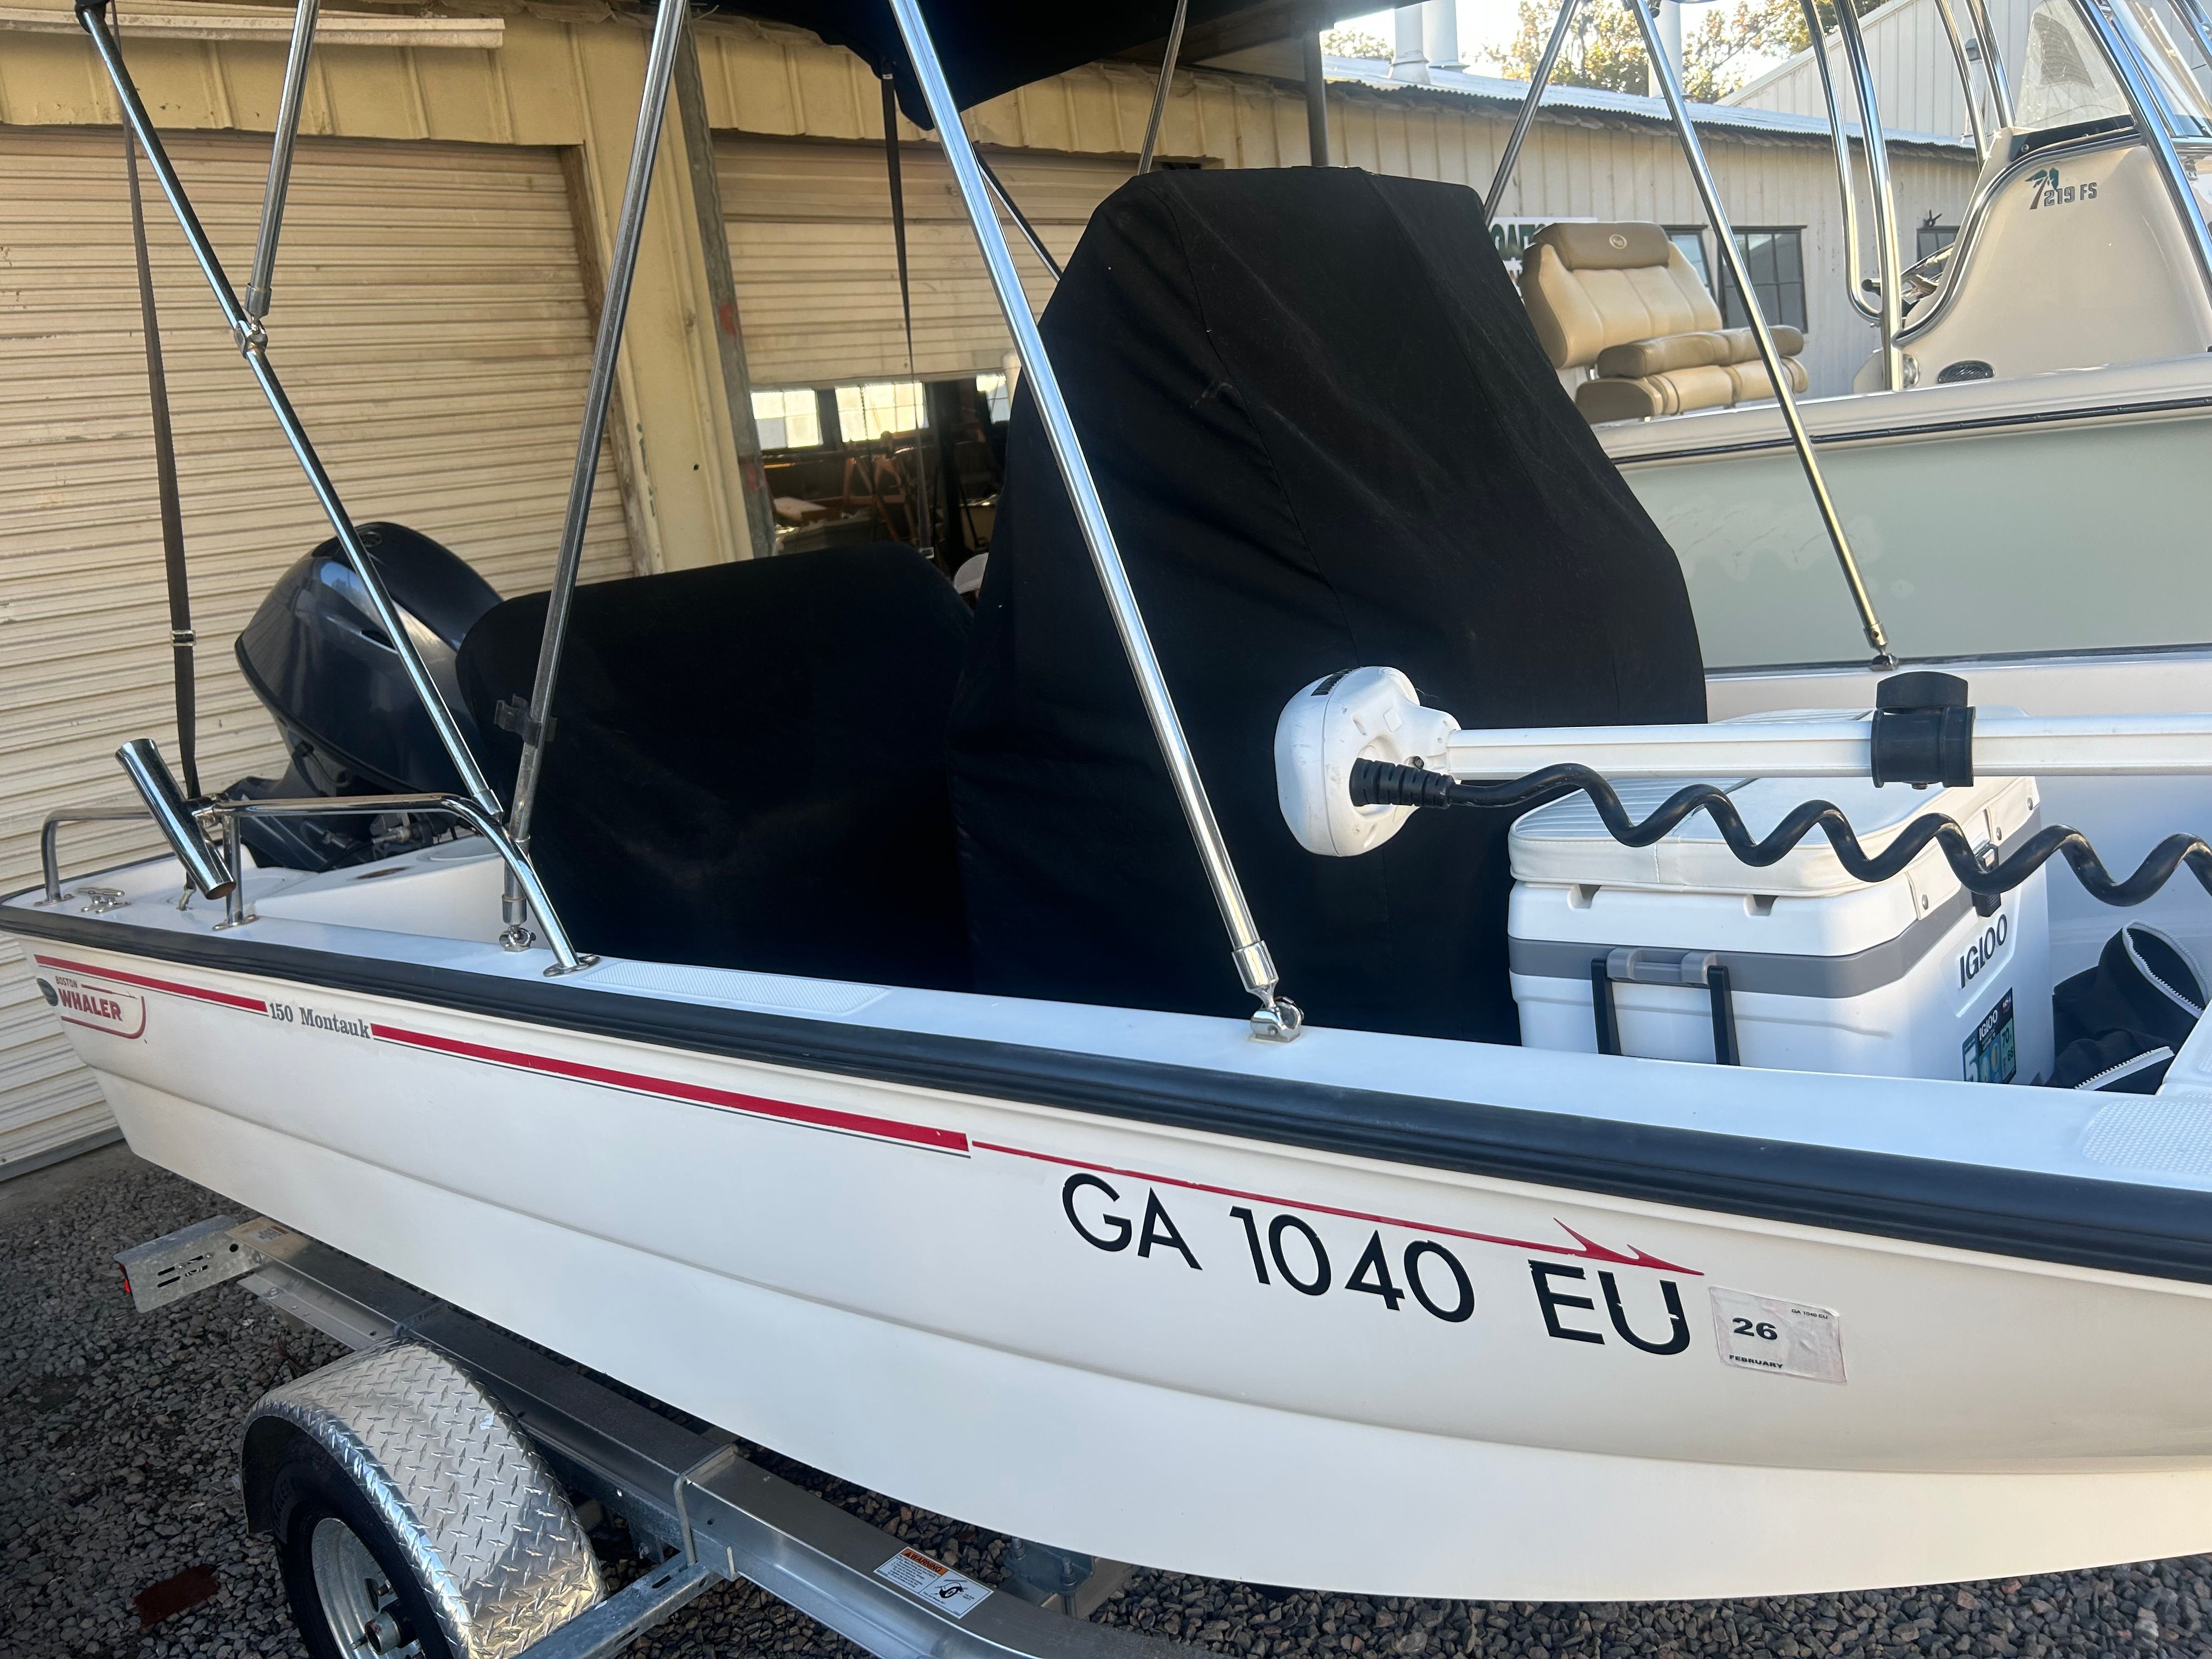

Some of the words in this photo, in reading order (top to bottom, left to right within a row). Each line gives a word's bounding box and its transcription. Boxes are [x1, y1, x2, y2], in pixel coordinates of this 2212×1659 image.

[2044, 186, 2075, 206] 219
[2080, 182, 2097, 201] FS
[1960, 914, 2007, 989] IGLOO
[55, 975, 78, 988] BOSTON
[58, 989, 123, 1022] WHALER
[270, 1002, 294, 1023] 150
[299, 1006, 371, 1039] Montauk
[1979, 1009, 1998, 1041] IGLOO
[1062, 1172, 1203, 1270] GA
[1229, 1205, 1475, 1323] 1040
[1527, 1259, 1690, 1355] EU
[1733, 1317, 1778, 1340] 26
[1729, 1354, 1783, 1368] FEBRUARY
[911, 1554, 943, 1573] WARNING
